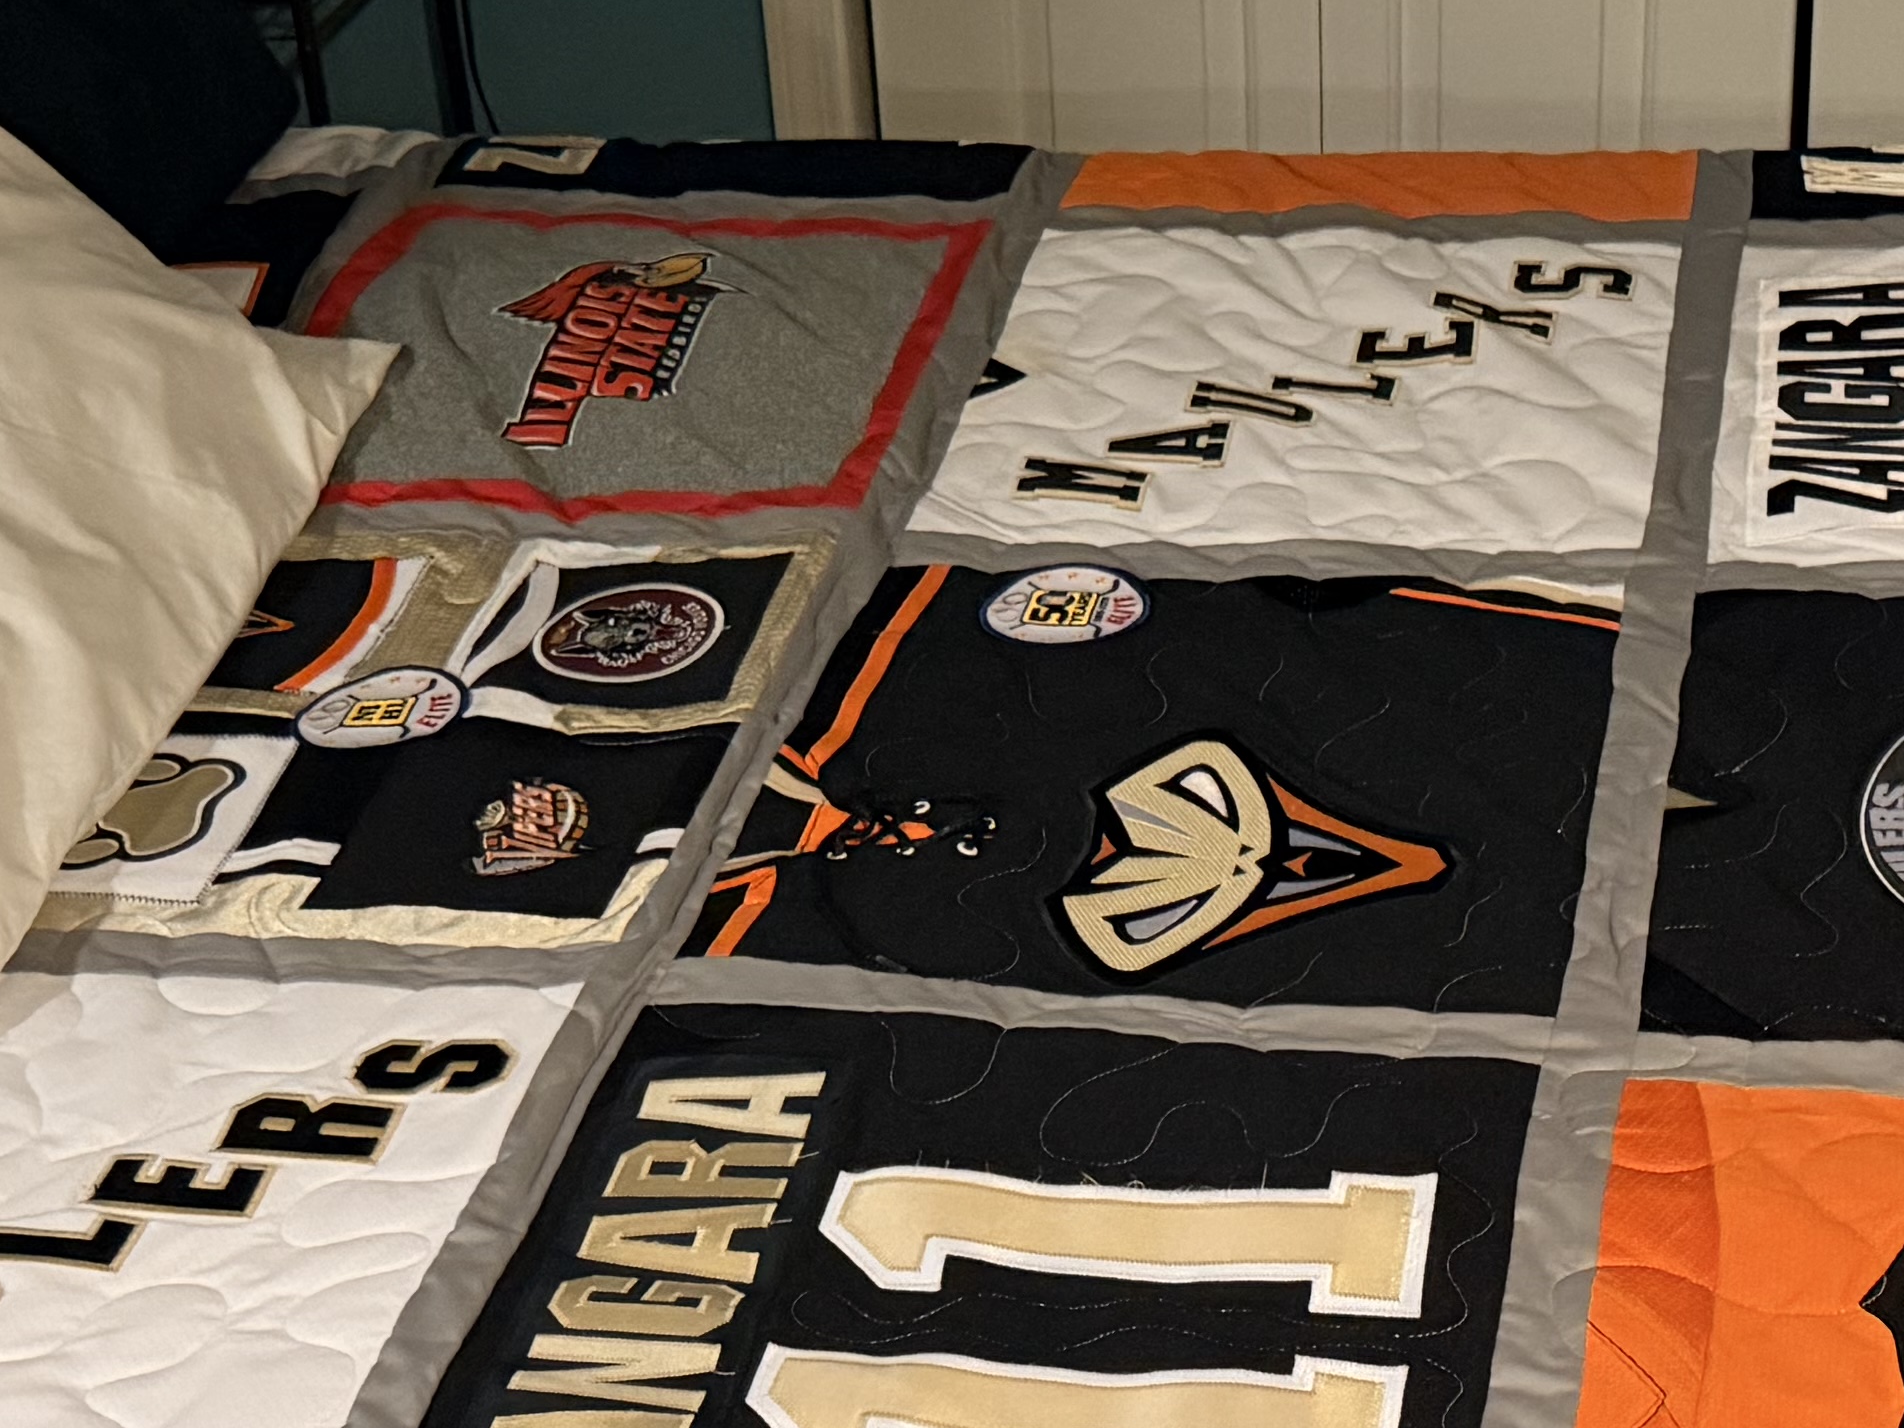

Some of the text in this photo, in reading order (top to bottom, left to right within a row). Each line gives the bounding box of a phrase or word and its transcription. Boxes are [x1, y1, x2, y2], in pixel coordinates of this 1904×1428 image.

[591, 288, 690, 401] STATE
[501, 281, 637, 446] ILLINOIS
[1028, 590, 1076, 625] 50
[1069, 592, 1093, 625] YEARS
[1107, 595, 1138, 625] ELITE
[416, 693, 455, 728] ELITE
[484, 780, 580, 864] VIPERS
